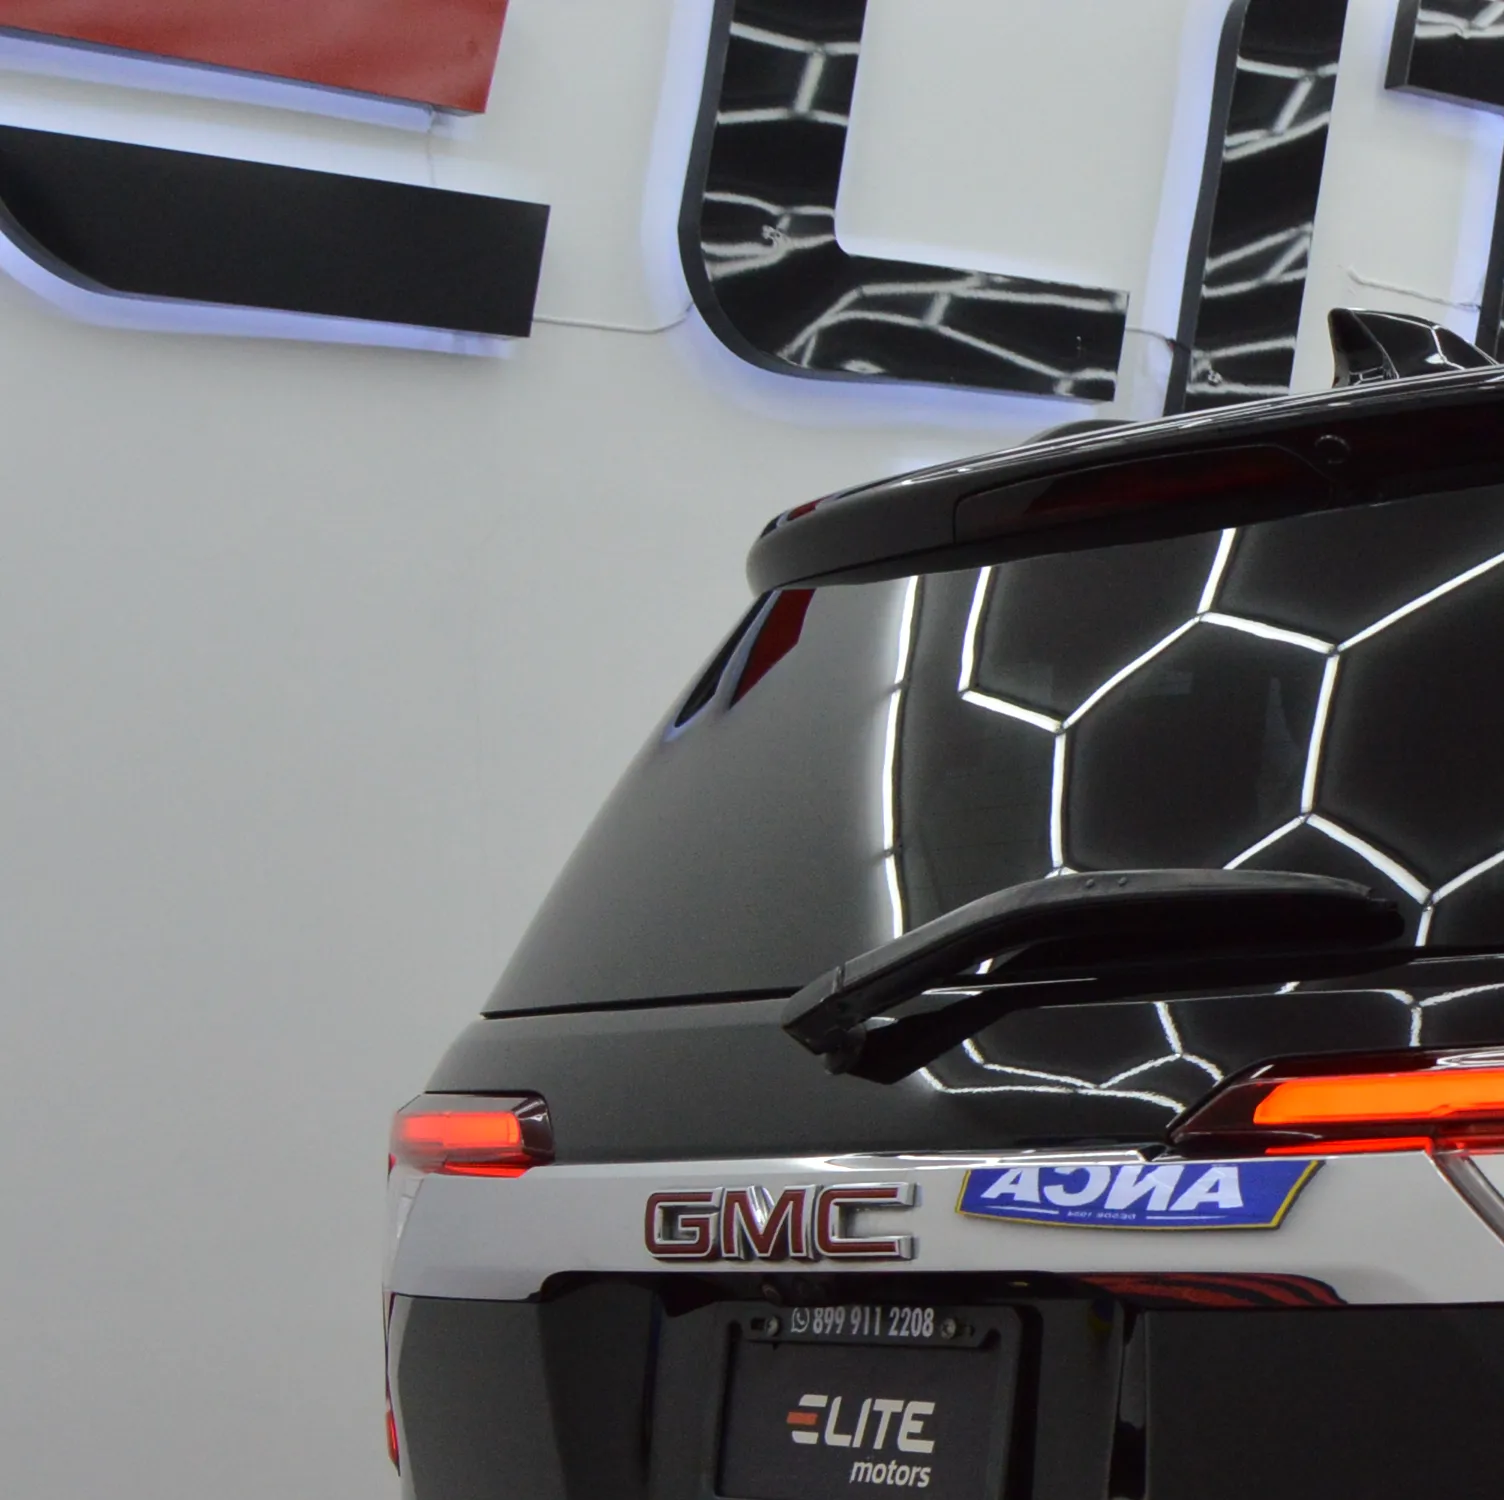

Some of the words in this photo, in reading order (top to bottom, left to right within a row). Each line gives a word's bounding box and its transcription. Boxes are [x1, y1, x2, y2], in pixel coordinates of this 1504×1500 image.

[643, 1181, 918, 1262] GMC
[813, 1306, 845, 1335] 899
[850, 1306, 881, 1337] 911
[888, 1306, 934, 1338] 2208
[786, 1393, 936, 1454] ELITE
[849, 1459, 931, 1489] motors
